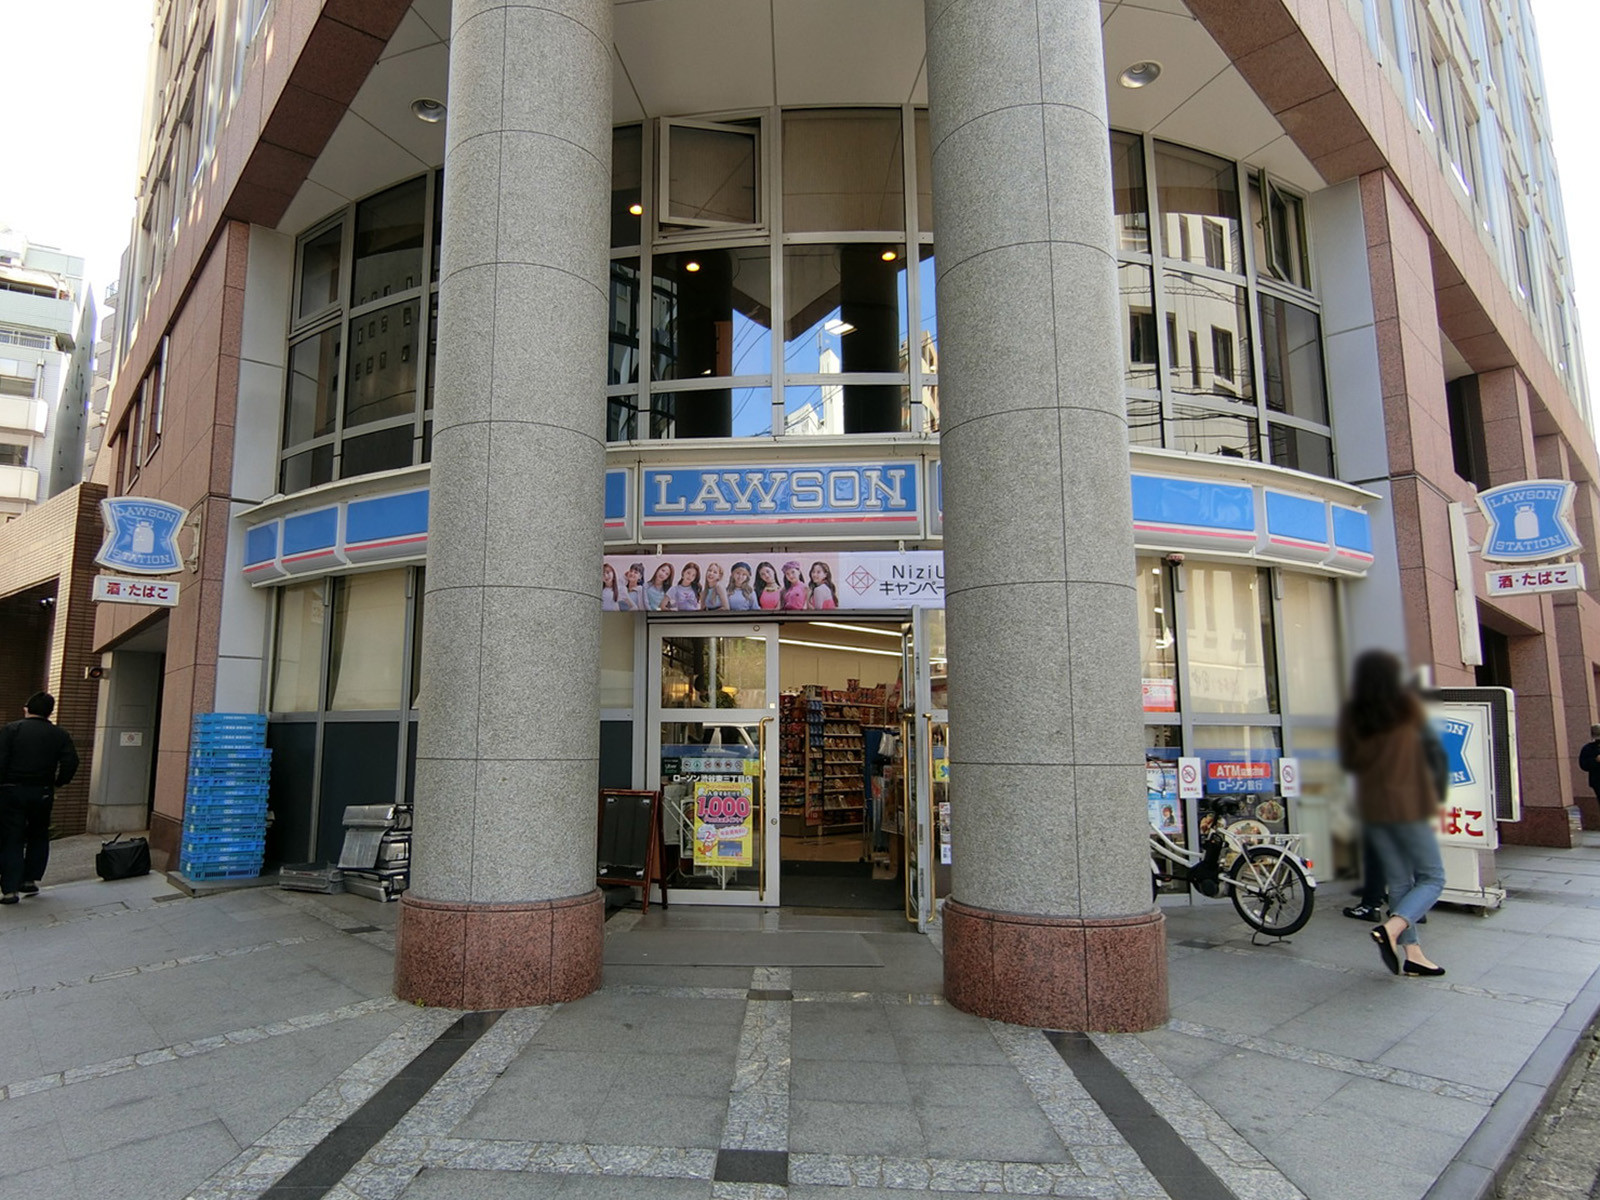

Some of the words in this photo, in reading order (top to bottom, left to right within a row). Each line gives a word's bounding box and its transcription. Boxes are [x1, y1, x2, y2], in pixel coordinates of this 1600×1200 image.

[654, 468, 907, 513] LAWSON
[1490, 489, 1558, 508] LAWSON
[115, 506, 176, 523] LAWSON
[1495, 534, 1562, 551] STATION
[111, 549, 170, 565] STATION
[1498, 571, 1569, 589] 酒・たばこ
[106, 582, 169, 599] 酒・たばこ
[1216, 765, 1240, 776] ATM
[1218, 780, 1263, 791] ローソン銀行
